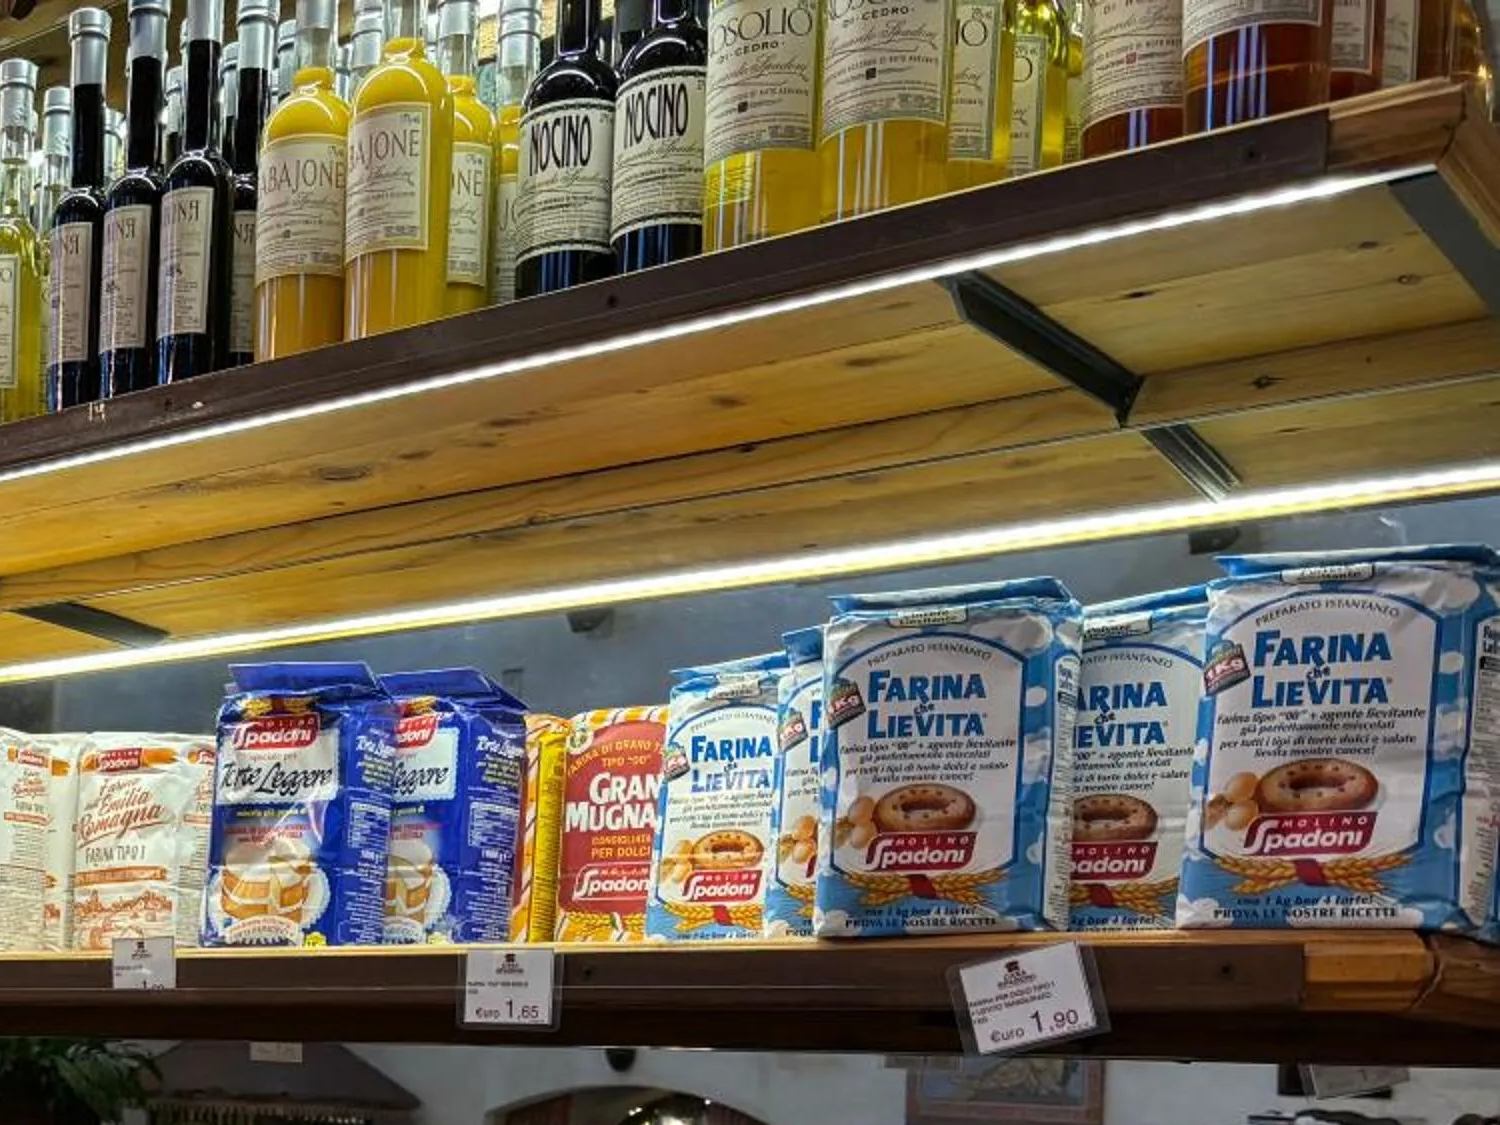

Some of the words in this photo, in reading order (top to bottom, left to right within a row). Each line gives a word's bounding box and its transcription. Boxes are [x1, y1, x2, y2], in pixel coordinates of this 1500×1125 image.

[861, 6, 911, 21] CEDRO
[711, 7, 813, 54] OSOLIO
[734, 40, 780, 56] CEDRO
[624, 83, 689, 149] NOCINO
[529, 115, 592, 177] NOCINO
[259, 158, 345, 195] ABAJONE
[1254, 599, 1321, 627] PREPARATO
[1253, 629, 1391, 667] FARINA
[867, 670, 987, 703] FARINA
[1306, 666, 1331, 681] che
[1075, 681, 1168, 715] ARINA
[1251, 675, 1389, 708] LIEVITA
[914, 702, 935, 715] che
[1319, 709, 1364, 722] agente
[1366, 706, 1426, 719] lievitante
[230, 722, 312, 748] Spadoni
[867, 710, 985, 739] LIEVITA
[1072, 721, 1167, 748] IEVITA
[1258, 722, 1341, 736] perfettamente
[1342, 719, 1396, 731] miscelati
[691, 735, 772, 764] FARINA
[1220, 739, 1237, 751] per
[1294, 734, 1307, 745] di
[1309, 734, 1338, 745] torte
[1381, 732, 1417, 744] salate
[260, 761, 333, 797] Leggere
[589, 772, 665, 804] GRAN
[691, 769, 771, 793] LIEVITA
[565, 805, 657, 832] MUGNA
[1282, 816, 1368, 829] MOLINO
[895, 836, 969, 847] MOLINO
[1244, 819, 1363, 853] Spadoni
[591, 848, 613, 859] PER
[865, 839, 966, 870] Spadoni
[683, 874, 755, 902] Spadoni
[1213, 908, 1260, 920] PROVA
[1282, 908, 1338, 919] NOSTRE
[505, 999, 539, 1020] 1,65
